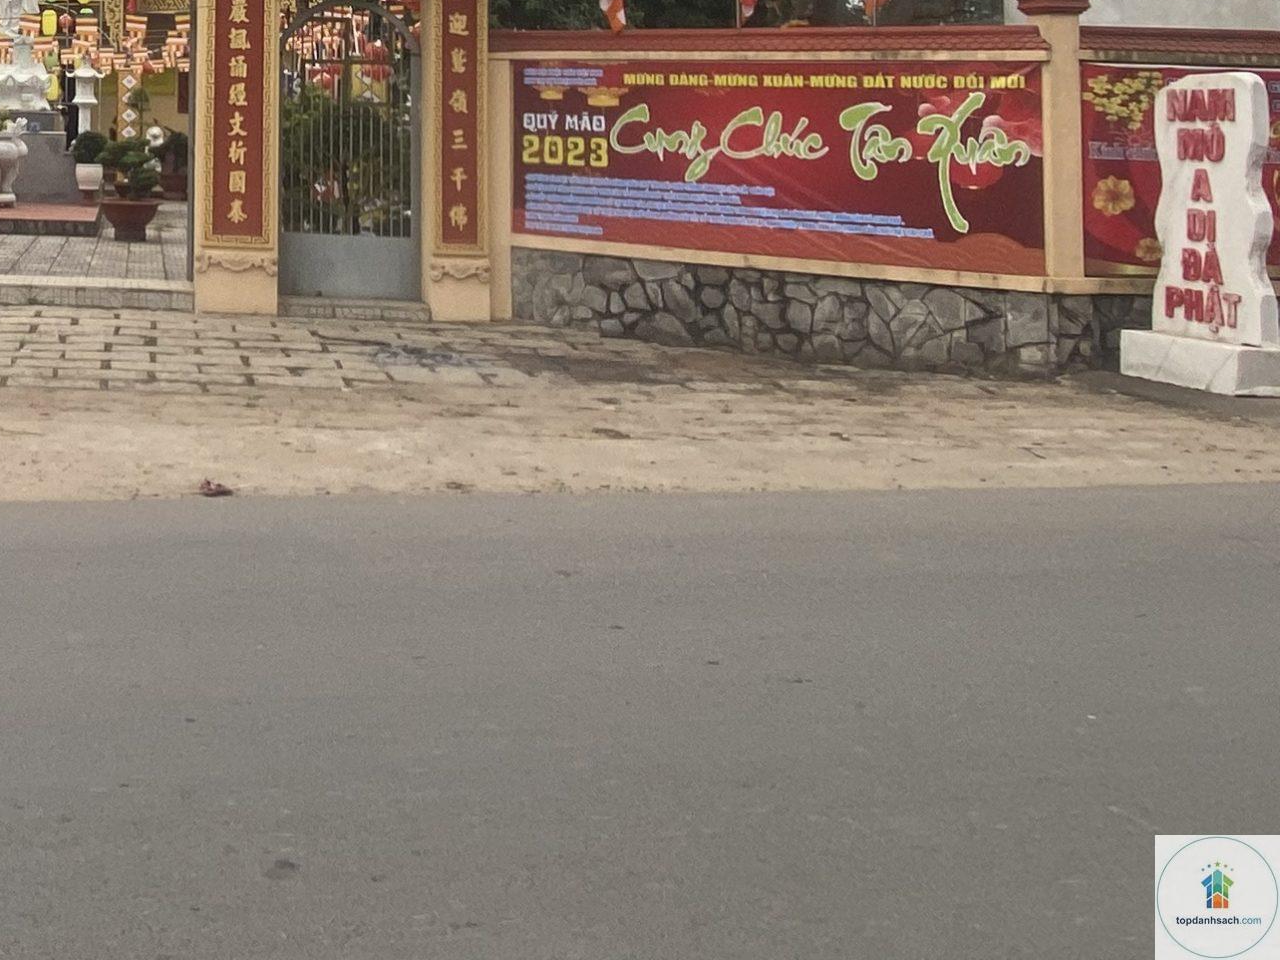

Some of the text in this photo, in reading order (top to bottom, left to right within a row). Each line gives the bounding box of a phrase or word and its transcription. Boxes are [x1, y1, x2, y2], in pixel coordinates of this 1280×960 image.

[522, 109, 607, 133] QUÝ MÃO
[1166, 87, 1236, 122] NAM
[521, 134, 610, 168] 2023
[609, 103, 720, 183] Cung
[720, 105, 830, 160] Chúc
[838, 101, 913, 181] Tân
[916, 91, 1032, 234] Xuân
[1190, 167, 1214, 204] A
[1186, 208, 1217, 243] DI
[1164, 284, 1243, 334] PHẬT
